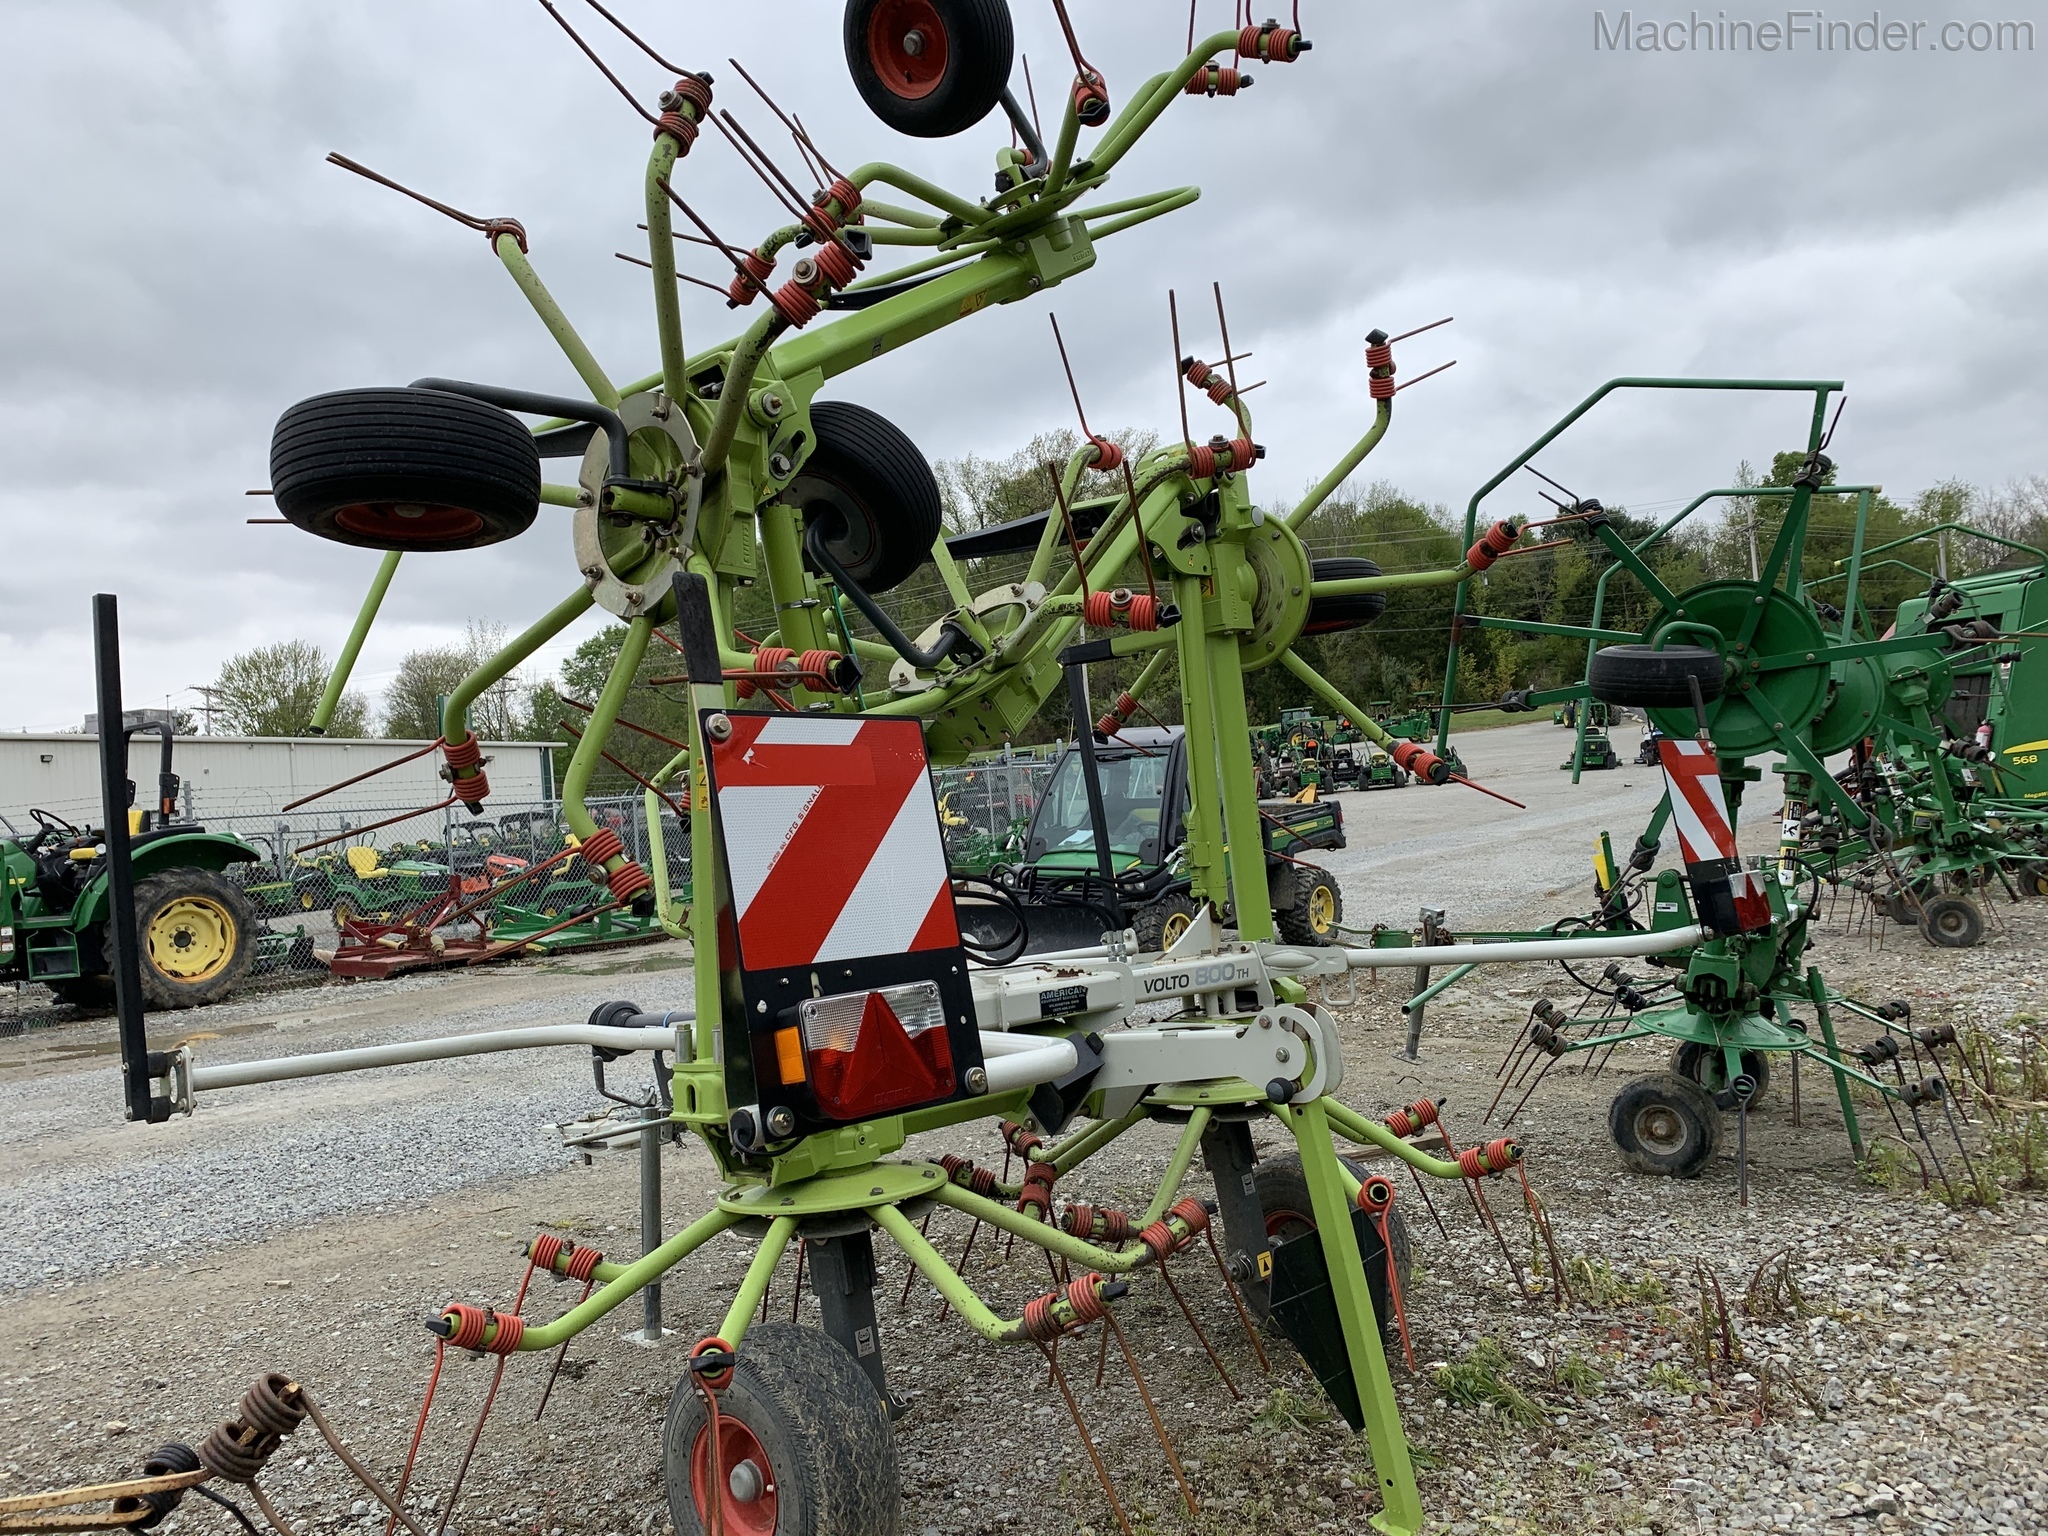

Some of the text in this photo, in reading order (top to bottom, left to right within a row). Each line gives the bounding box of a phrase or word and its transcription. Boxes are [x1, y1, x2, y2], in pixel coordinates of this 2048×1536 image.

[2012, 754, 2038, 765] 568
[785, 821, 799, 841] CFG
[1144, 962, 1249, 994] VOLTO 800 TH
[1040, 986, 1087, 1000] AMERICAN
